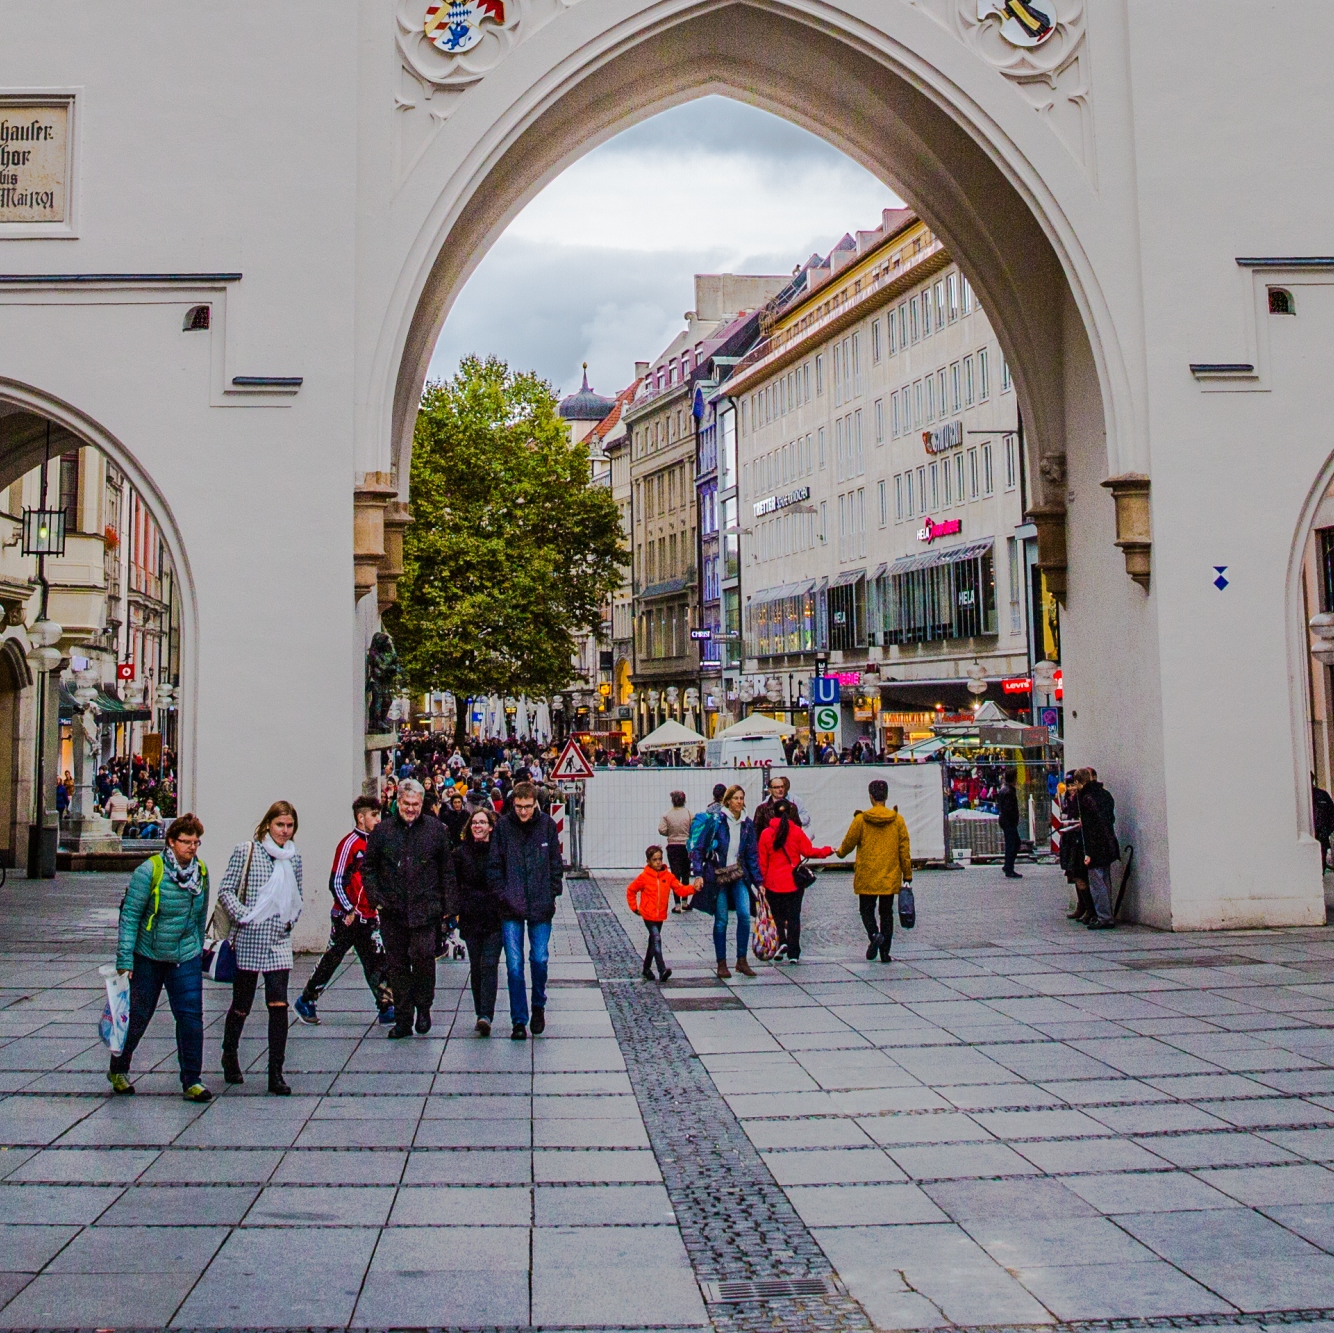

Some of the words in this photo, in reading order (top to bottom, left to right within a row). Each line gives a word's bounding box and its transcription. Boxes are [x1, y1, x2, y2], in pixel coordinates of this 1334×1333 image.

[0, 169, 18, 185] bis
[819, 679, 834, 701] U
[820, 708, 835, 728] S
